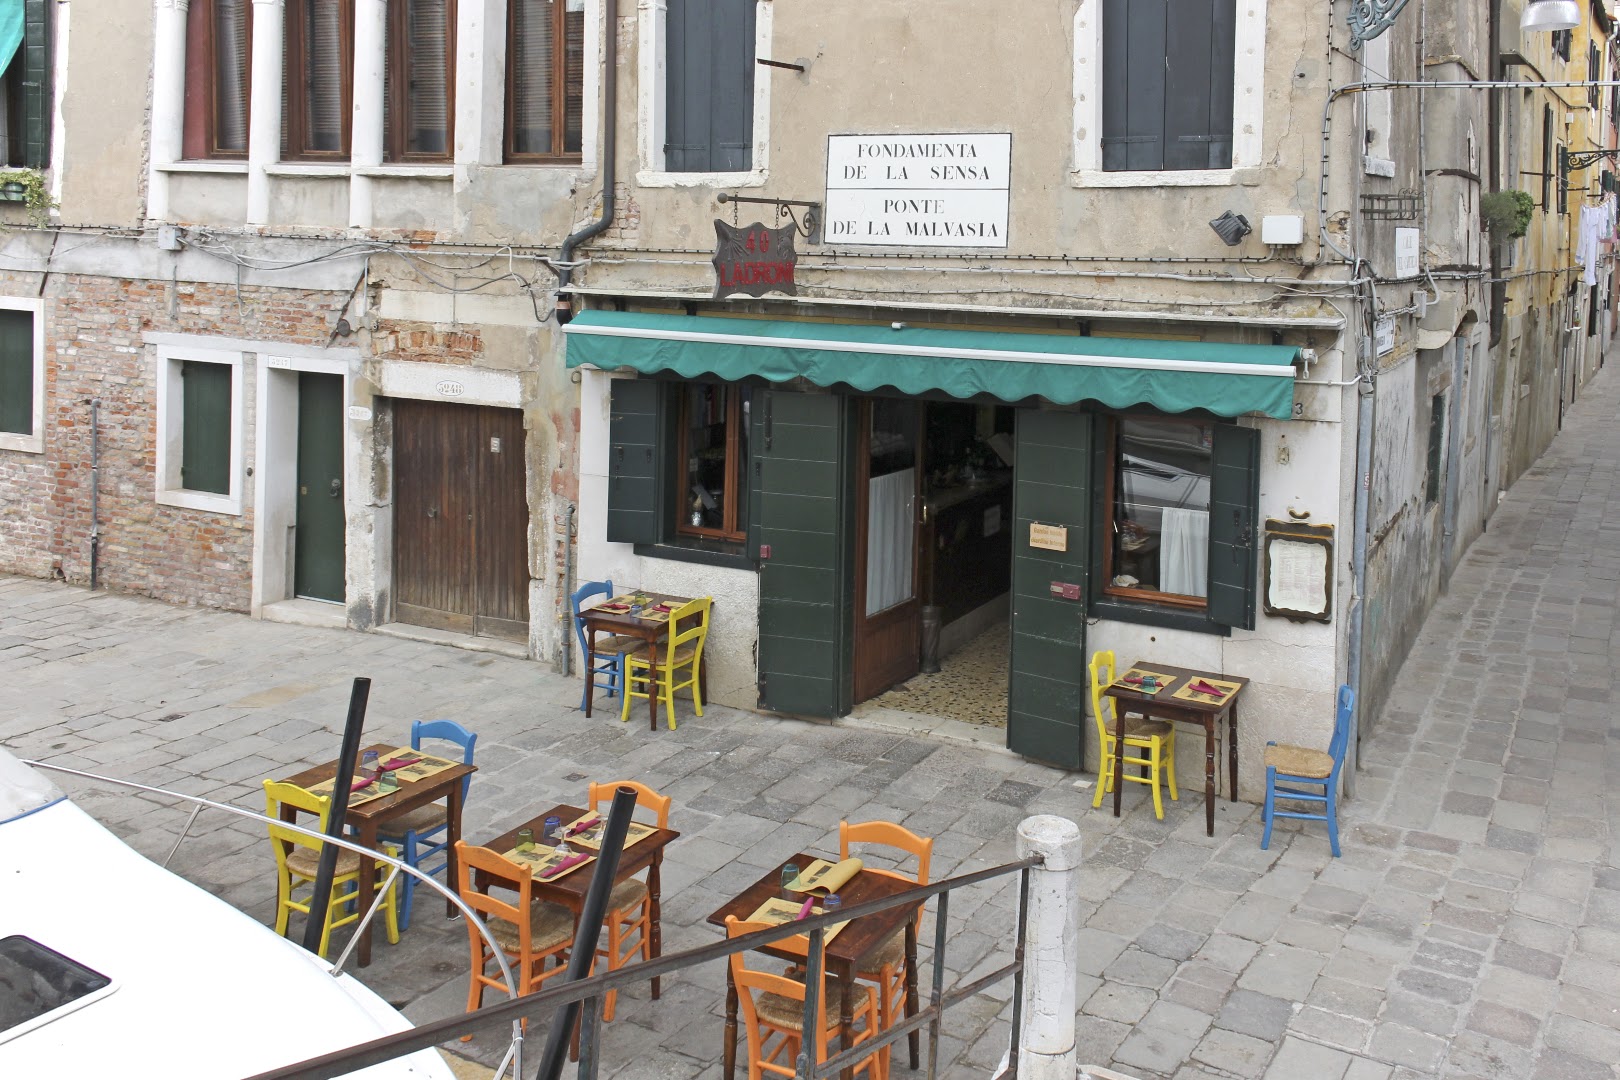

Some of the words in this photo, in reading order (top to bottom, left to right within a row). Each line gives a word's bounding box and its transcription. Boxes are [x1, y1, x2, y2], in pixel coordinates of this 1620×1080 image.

[857, 143, 978, 158] FONDAMENTA
[843, 165, 867, 180] DE
[886, 165, 909, 180] LA
[930, 165, 990, 180] SENSA
[884, 199, 945, 214] PONTE
[833, 220, 857, 235] DE
[868, 221, 891, 236] LA
[905, 222, 998, 237] MALVASIA
[745, 230, 769, 254] 40
[720, 261, 795, 287] LADRONI
